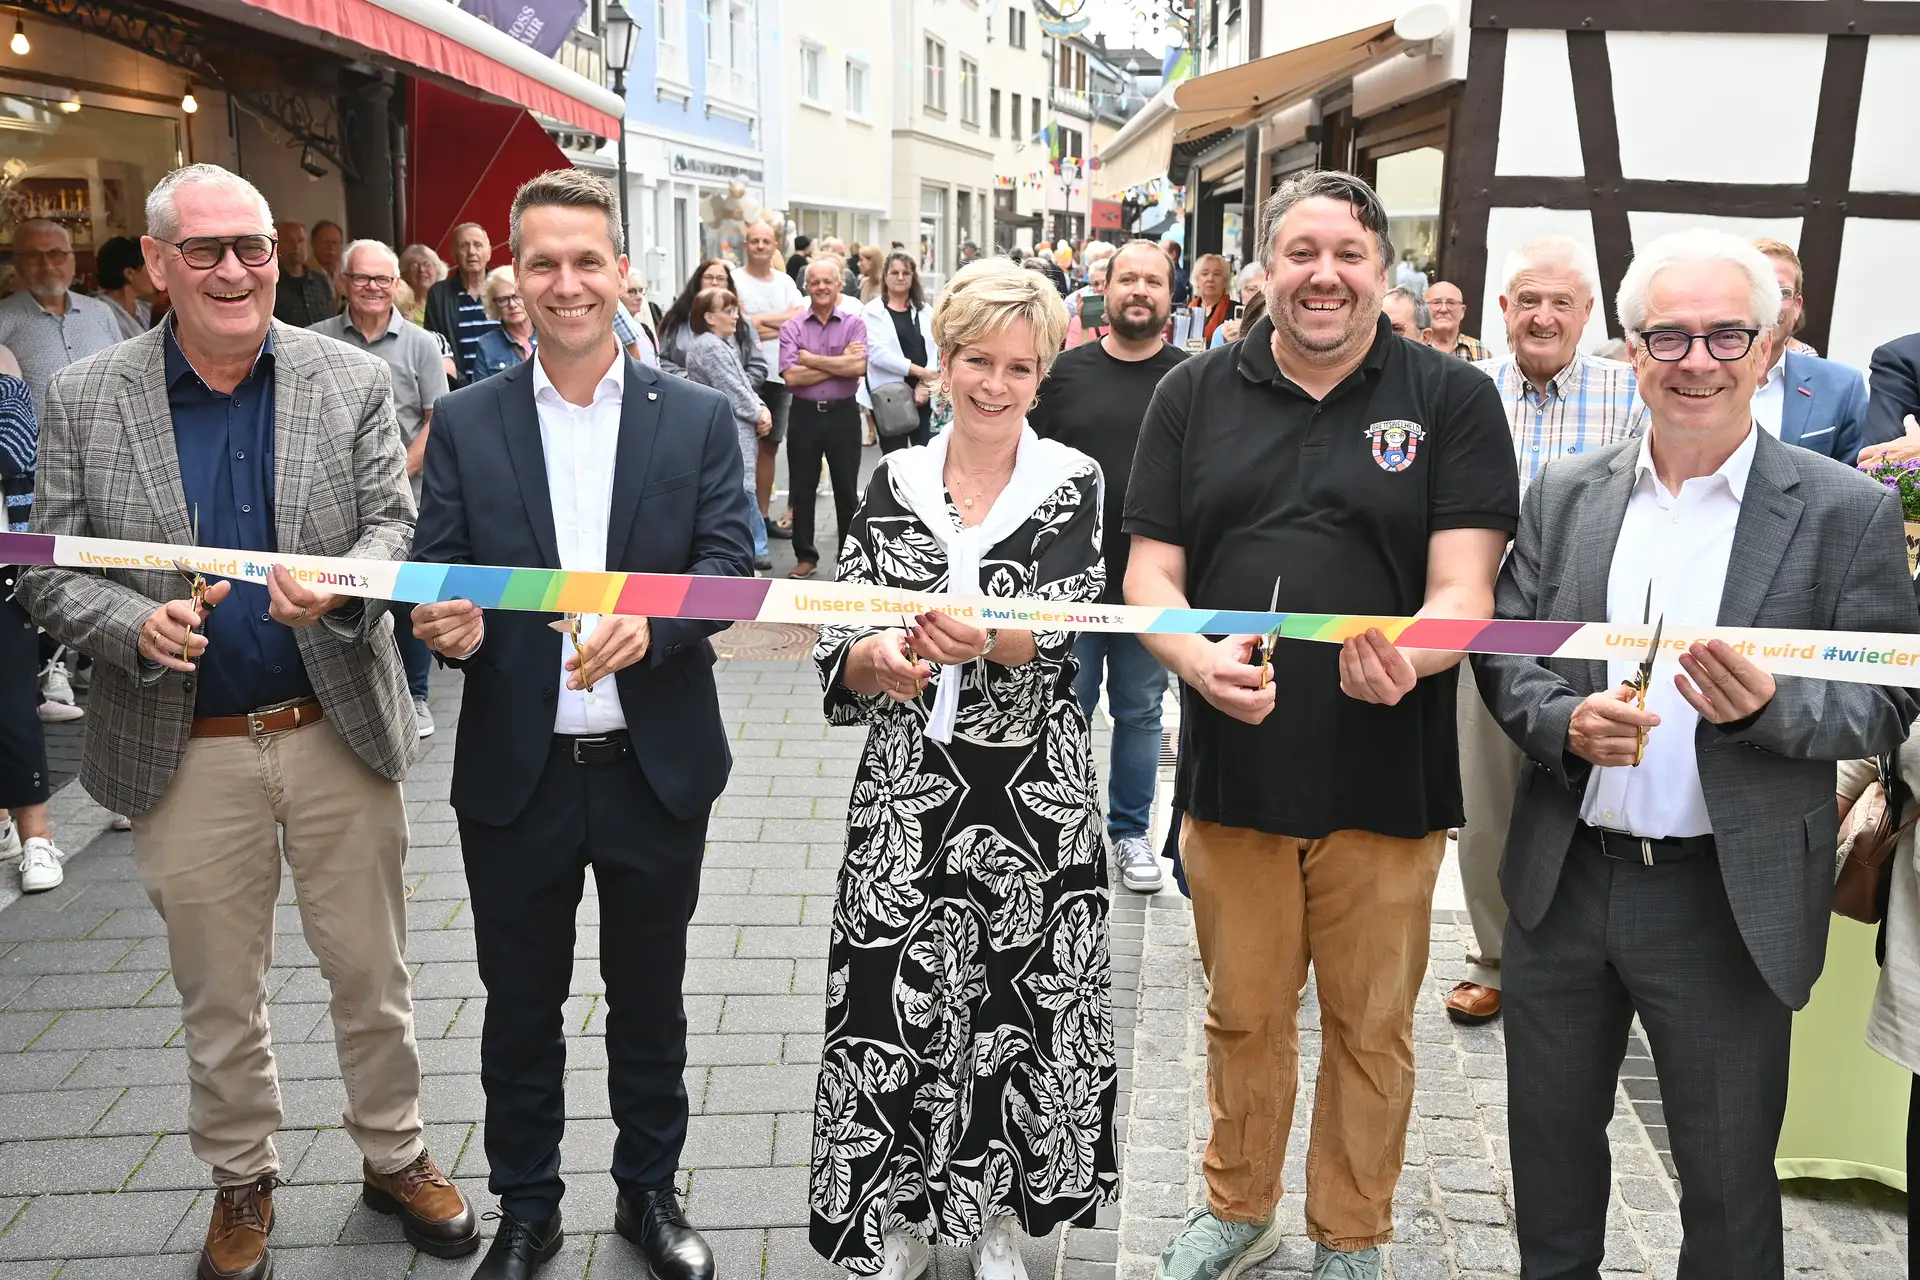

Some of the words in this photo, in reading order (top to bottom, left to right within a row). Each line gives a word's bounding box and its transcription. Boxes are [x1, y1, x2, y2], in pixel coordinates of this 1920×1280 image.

[79, 551, 140, 567] Unsere
[143, 554, 192, 568] Stat
[196, 558, 237, 576] wird
[795, 595, 866, 612] Unsere
[870, 598, 924, 614] Stadt
[980, 608, 1109, 624] #wiederbunt
[1763, 643, 1816, 660] wird
